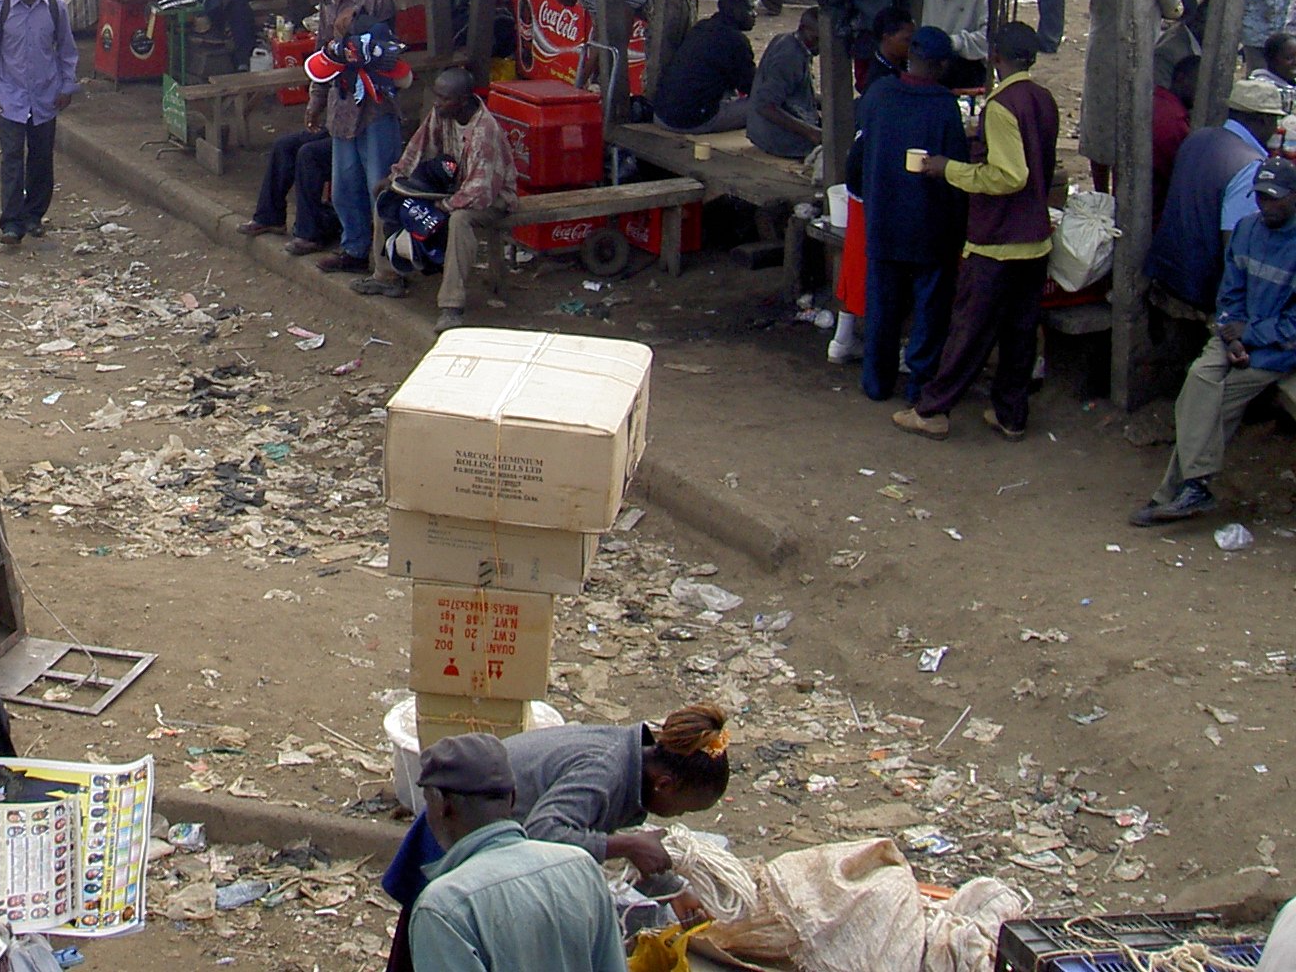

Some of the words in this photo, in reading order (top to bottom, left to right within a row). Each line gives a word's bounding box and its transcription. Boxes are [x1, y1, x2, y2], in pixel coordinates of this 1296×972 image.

[538, 0, 579, 42] Coca-Cola
[455, 450, 489, 460] NARCOL
[492, 454, 544, 467] ALUMINIUM
[456, 458, 495, 469] ROLLING
[498, 463, 523, 473] MILLS
[525, 465, 542, 474] LTD
[440, 611, 455, 623] kgs
[439, 625, 454, 637] kgs
[465, 628, 478, 638] 20
[434, 639, 453, 650] DOZ
